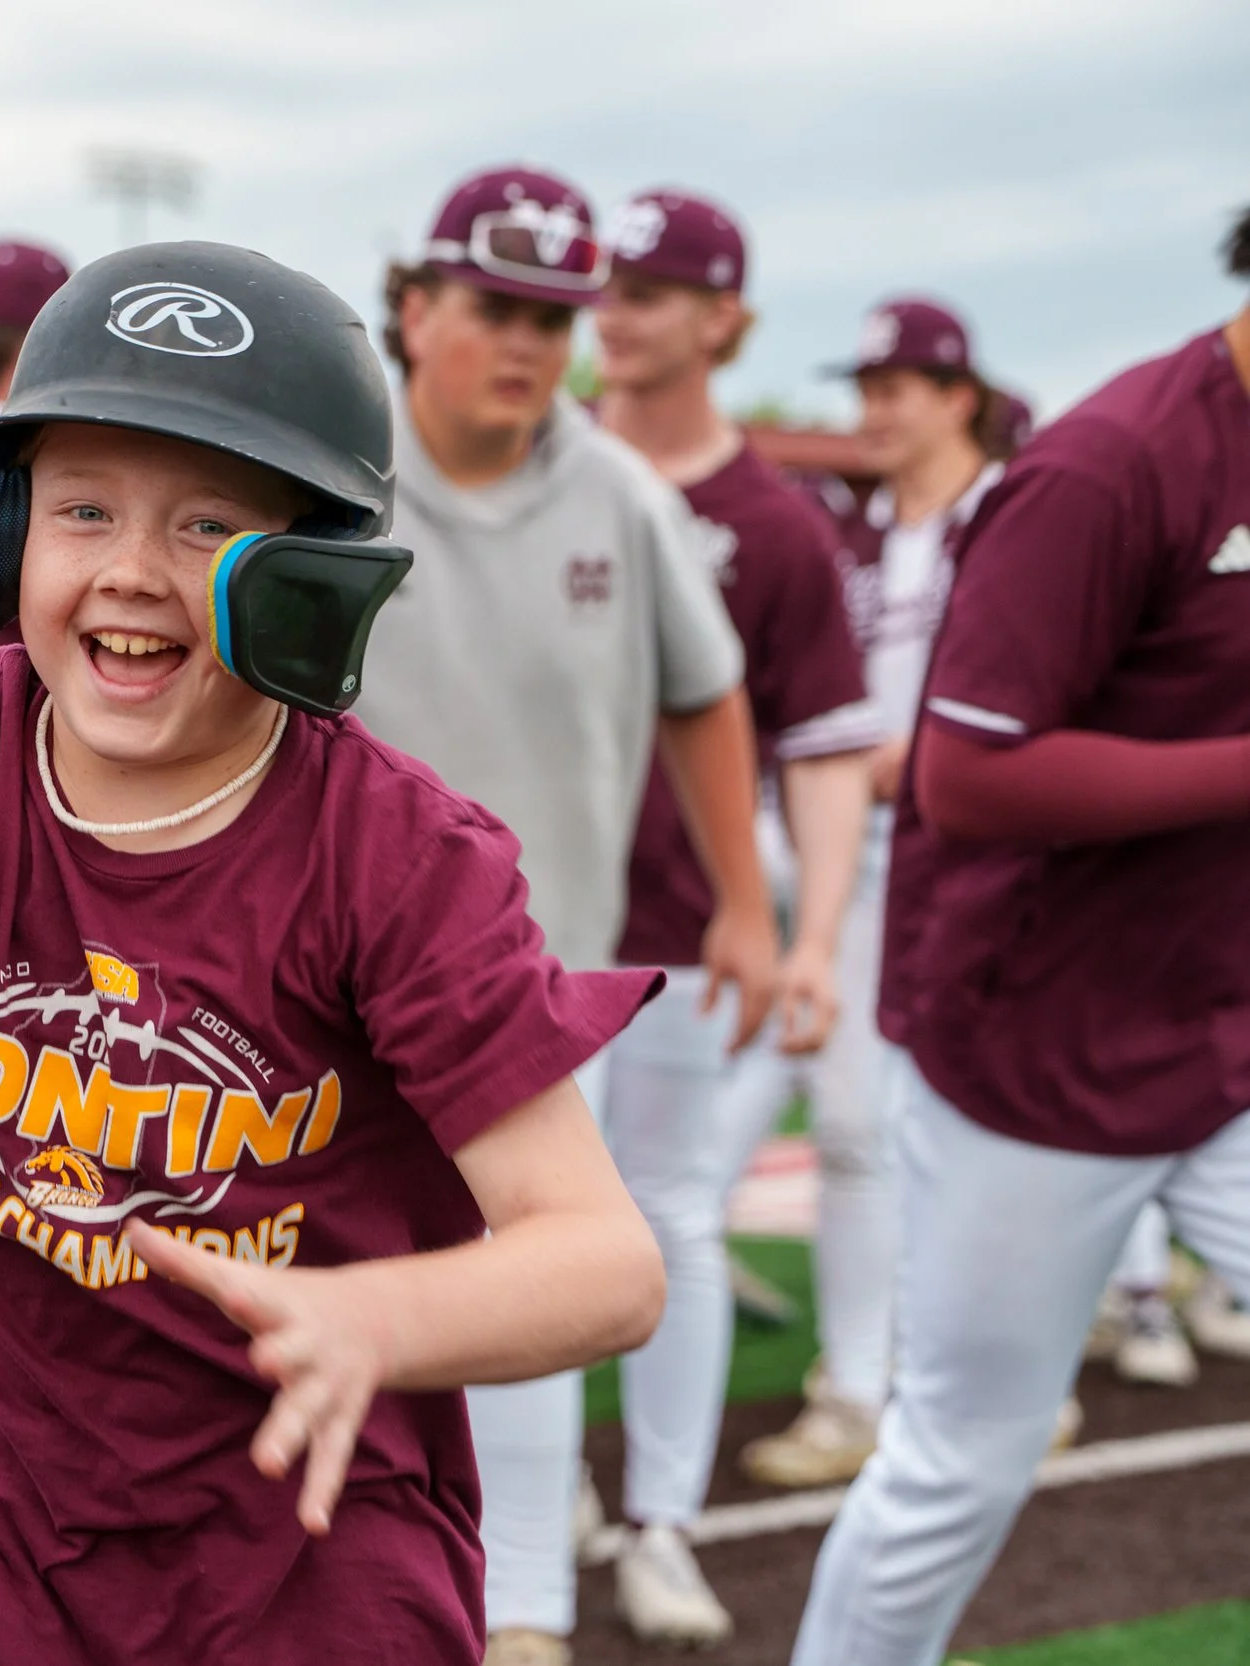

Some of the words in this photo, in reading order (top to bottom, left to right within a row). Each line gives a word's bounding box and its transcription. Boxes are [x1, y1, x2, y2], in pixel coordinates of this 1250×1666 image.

[117, 291, 223, 348] R
[68, 1024, 109, 1064] 20
[191, 1006, 275, 1084] FOOTBALL
